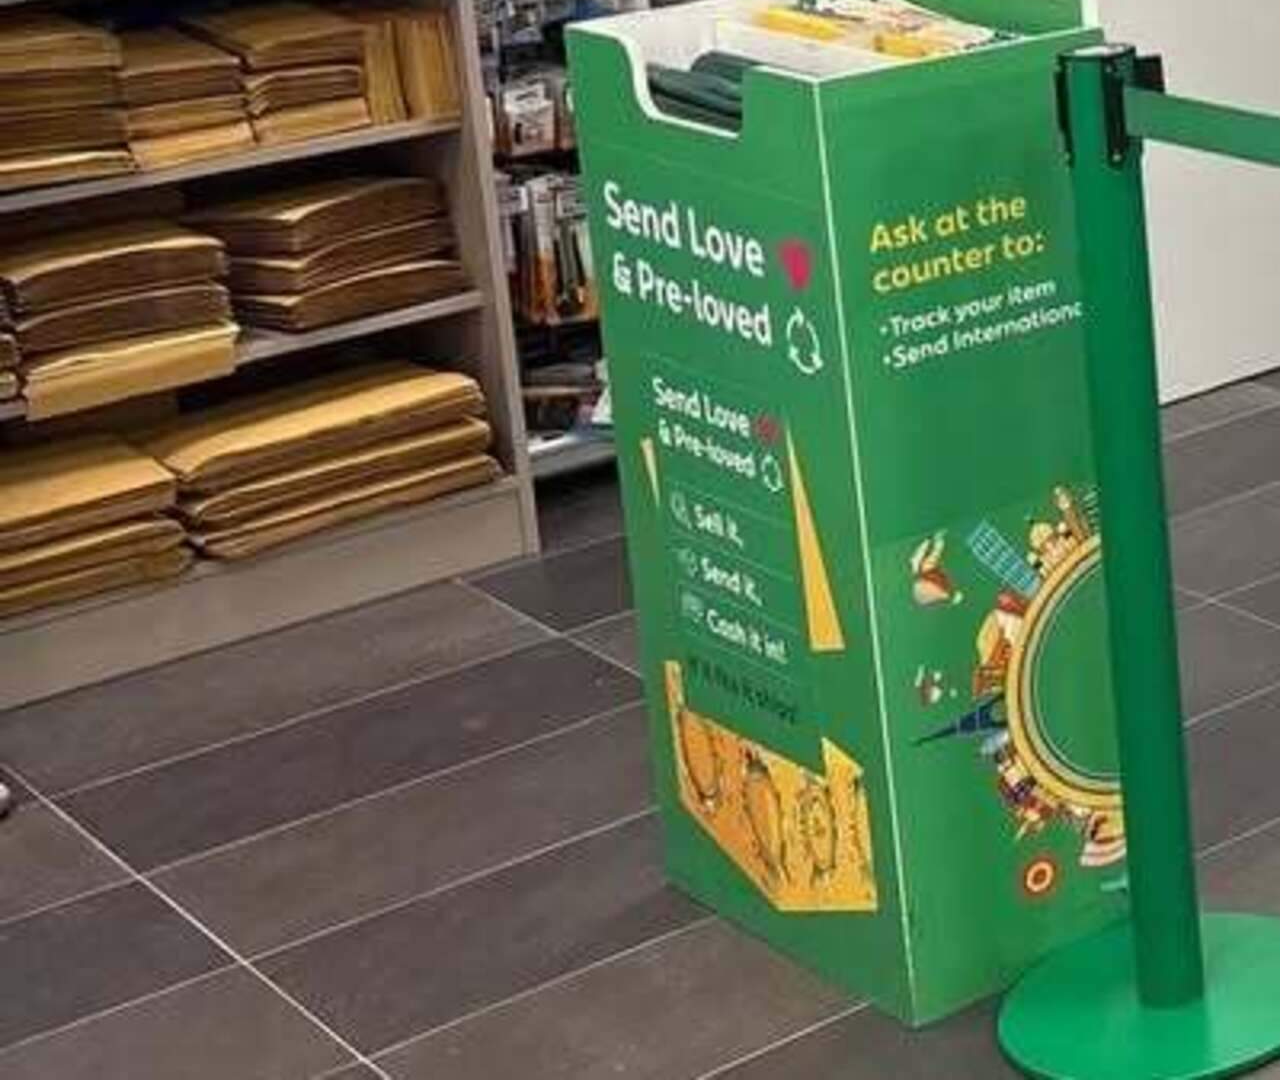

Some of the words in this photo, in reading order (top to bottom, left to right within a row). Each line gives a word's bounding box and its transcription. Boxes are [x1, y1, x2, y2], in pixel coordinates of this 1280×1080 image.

[603, 180, 682, 249] Send
[687, 206, 765, 278] Love
[869, 215, 929, 254] Ask
[934, 204, 970, 237] at
[976, 195, 1027, 226] the
[872, 244, 997, 292] counter
[1002, 232, 1045, 259] to:
[613, 251, 632, 295] &
[636, 257, 773, 348] Pre-loved
[889, 304, 951, 338] Track
[953, 293, 1004, 323] your
[1006, 279, 1056, 306] item
[891, 333, 949, 368] Send
[652, 376, 701, 419] Send
[703, 393, 751, 438] Love
[673, 423, 756, 479] Pre-loved
[701, 556, 741, 595] Send
